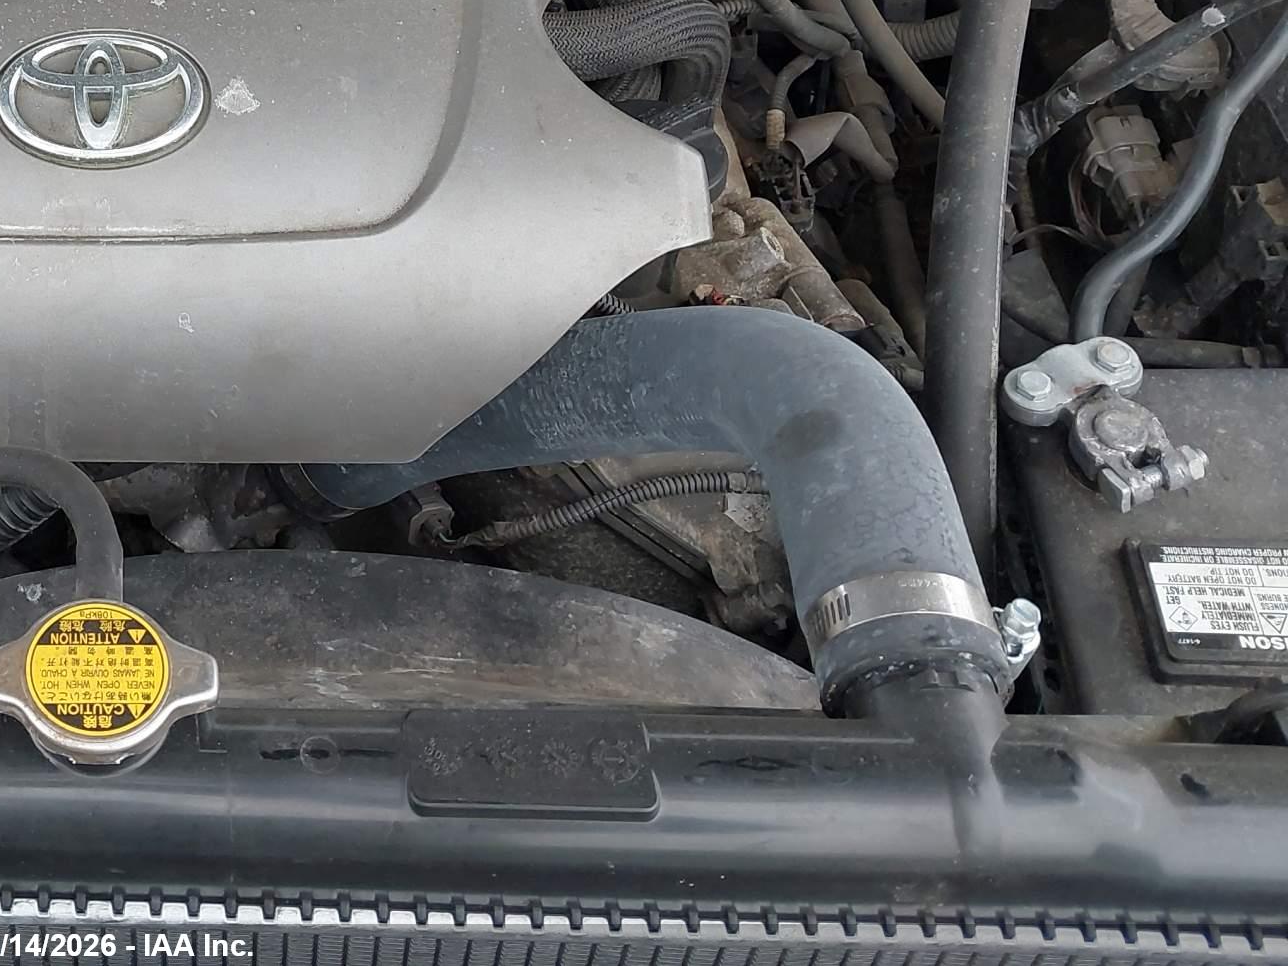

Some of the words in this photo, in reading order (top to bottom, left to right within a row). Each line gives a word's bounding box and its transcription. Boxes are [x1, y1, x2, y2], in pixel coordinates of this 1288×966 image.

[1225, 568, 1241, 576] NOT
[1242, 568, 1253, 576] DO
[1204, 575, 1225, 584] OPEN
[1228, 576, 1243, 584] NOT
[1244, 577, 1257, 585] DO
[1188, 587, 1207, 596] HELP
[1209, 587, 1246, 597] MEDICAL
[1166, 596, 1181, 604] GET
[1231, 602, 1254, 611] WITH
[80, 610, 113, 619] 108kPa
[1201, 611, 1256, 621] IMMEDIATELY
[1211, 621, 1231, 630] EYES
[1233, 621, 1259, 631] FLUSH
[50, 633, 121, 644] ATTENTION
[81, 669, 109, 677] OUVRIR
[113, 669, 139, 678] JAMAIS
[145, 669, 155, 677] NE
[40, 680, 60, 689] HOT.
[66, 680, 90, 689] WHEN
[97, 680, 120, 689] OPEN
[127, 680, 155, 689] NEVER
[57, 703, 125, 715] CAUTION
